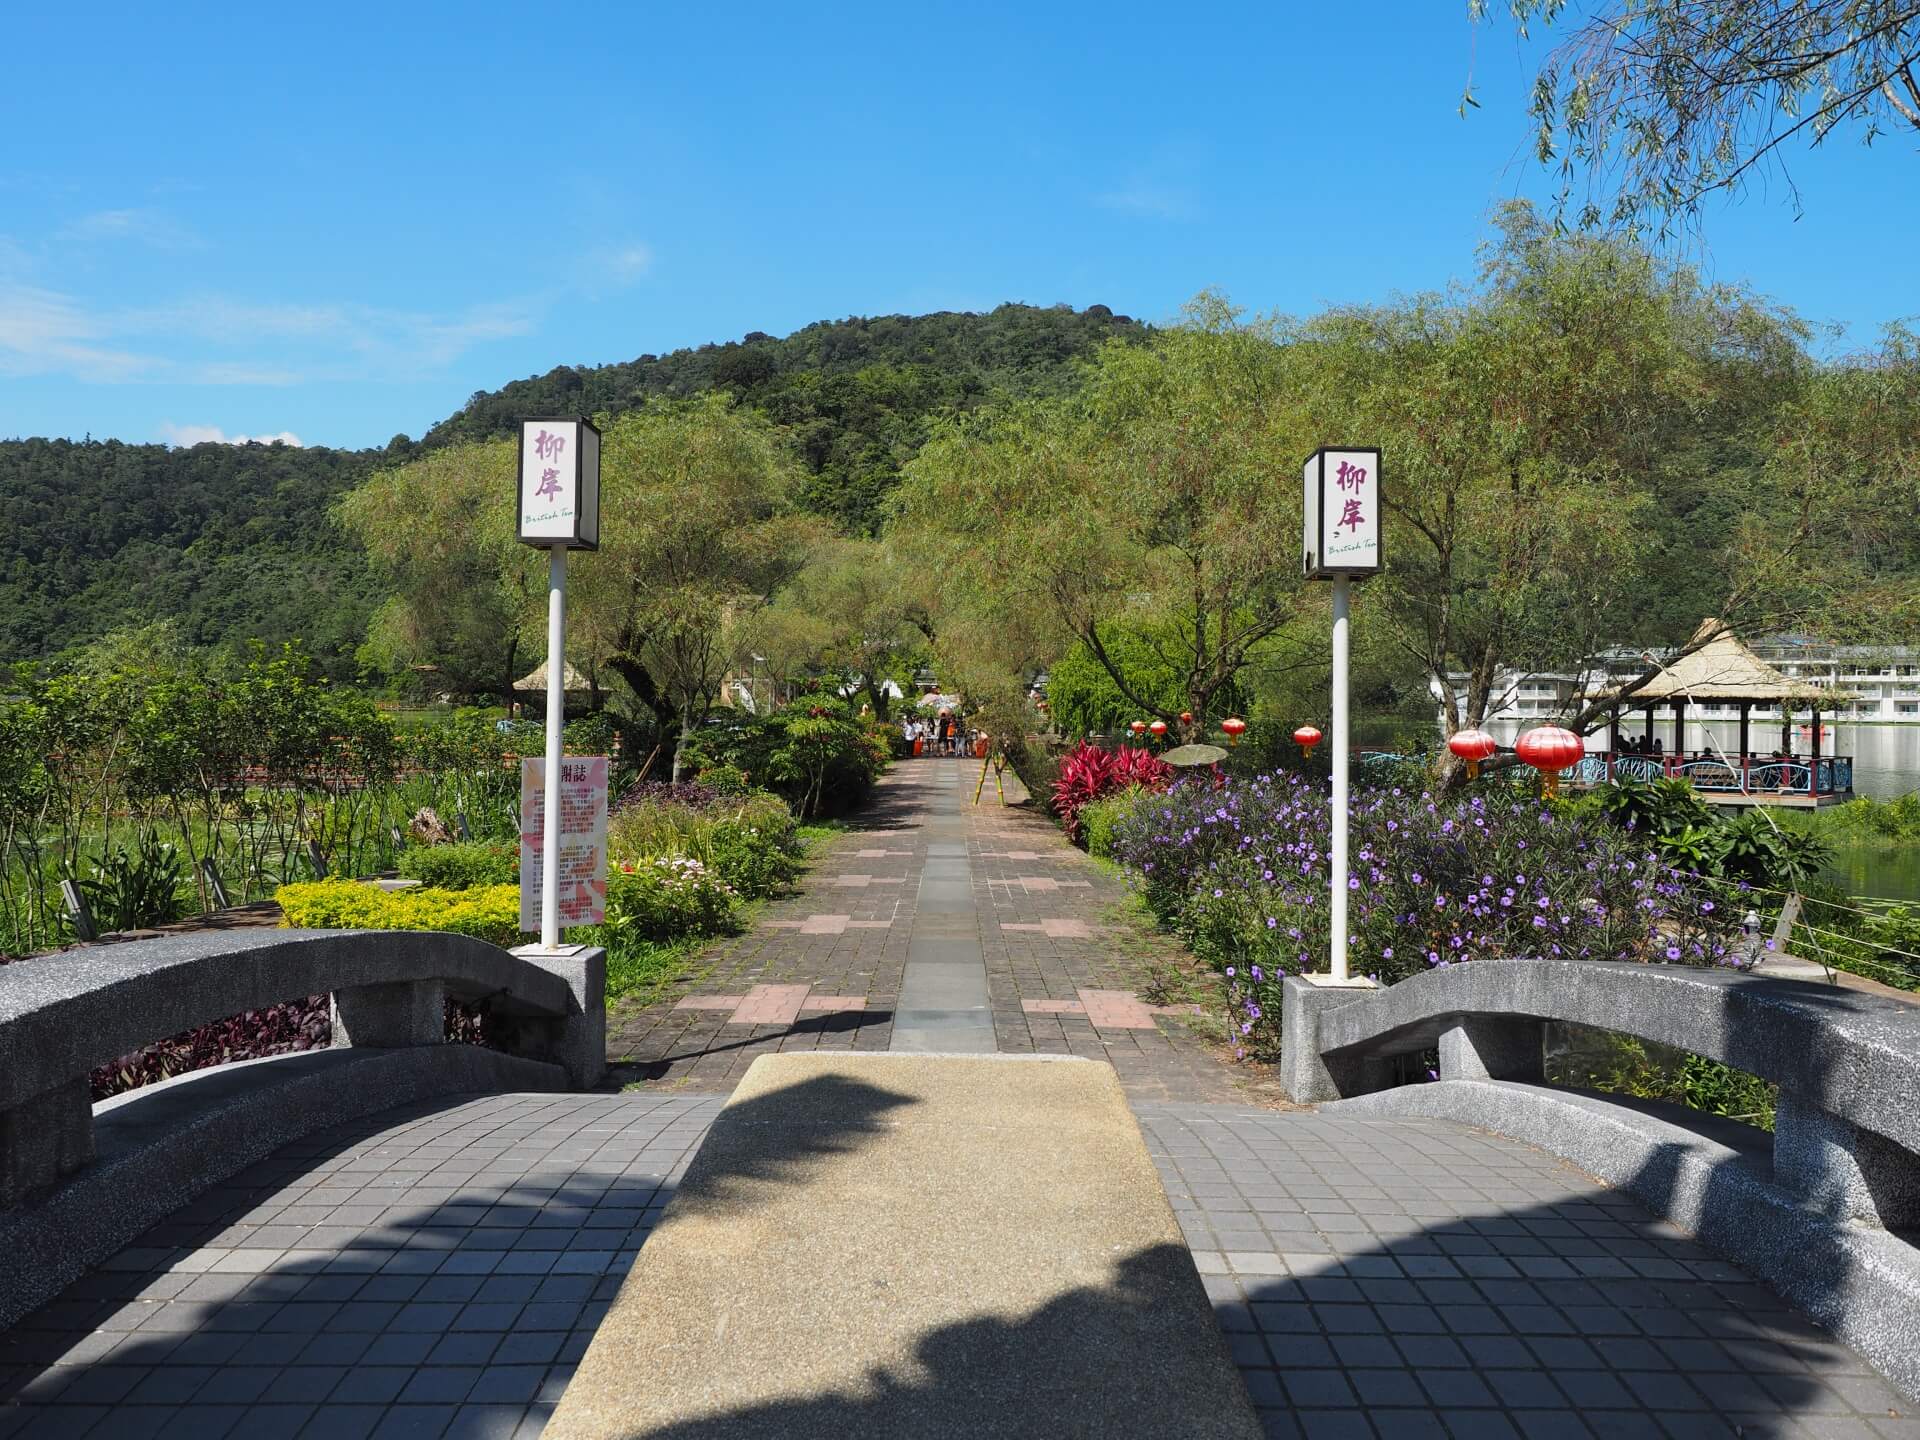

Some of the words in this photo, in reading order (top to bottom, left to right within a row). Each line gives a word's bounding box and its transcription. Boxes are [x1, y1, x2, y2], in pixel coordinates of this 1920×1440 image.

[535, 430, 565, 502] 柳岸
[1336, 461, 1367, 532] 柳岸
[561, 764, 587, 782] 謝誌
